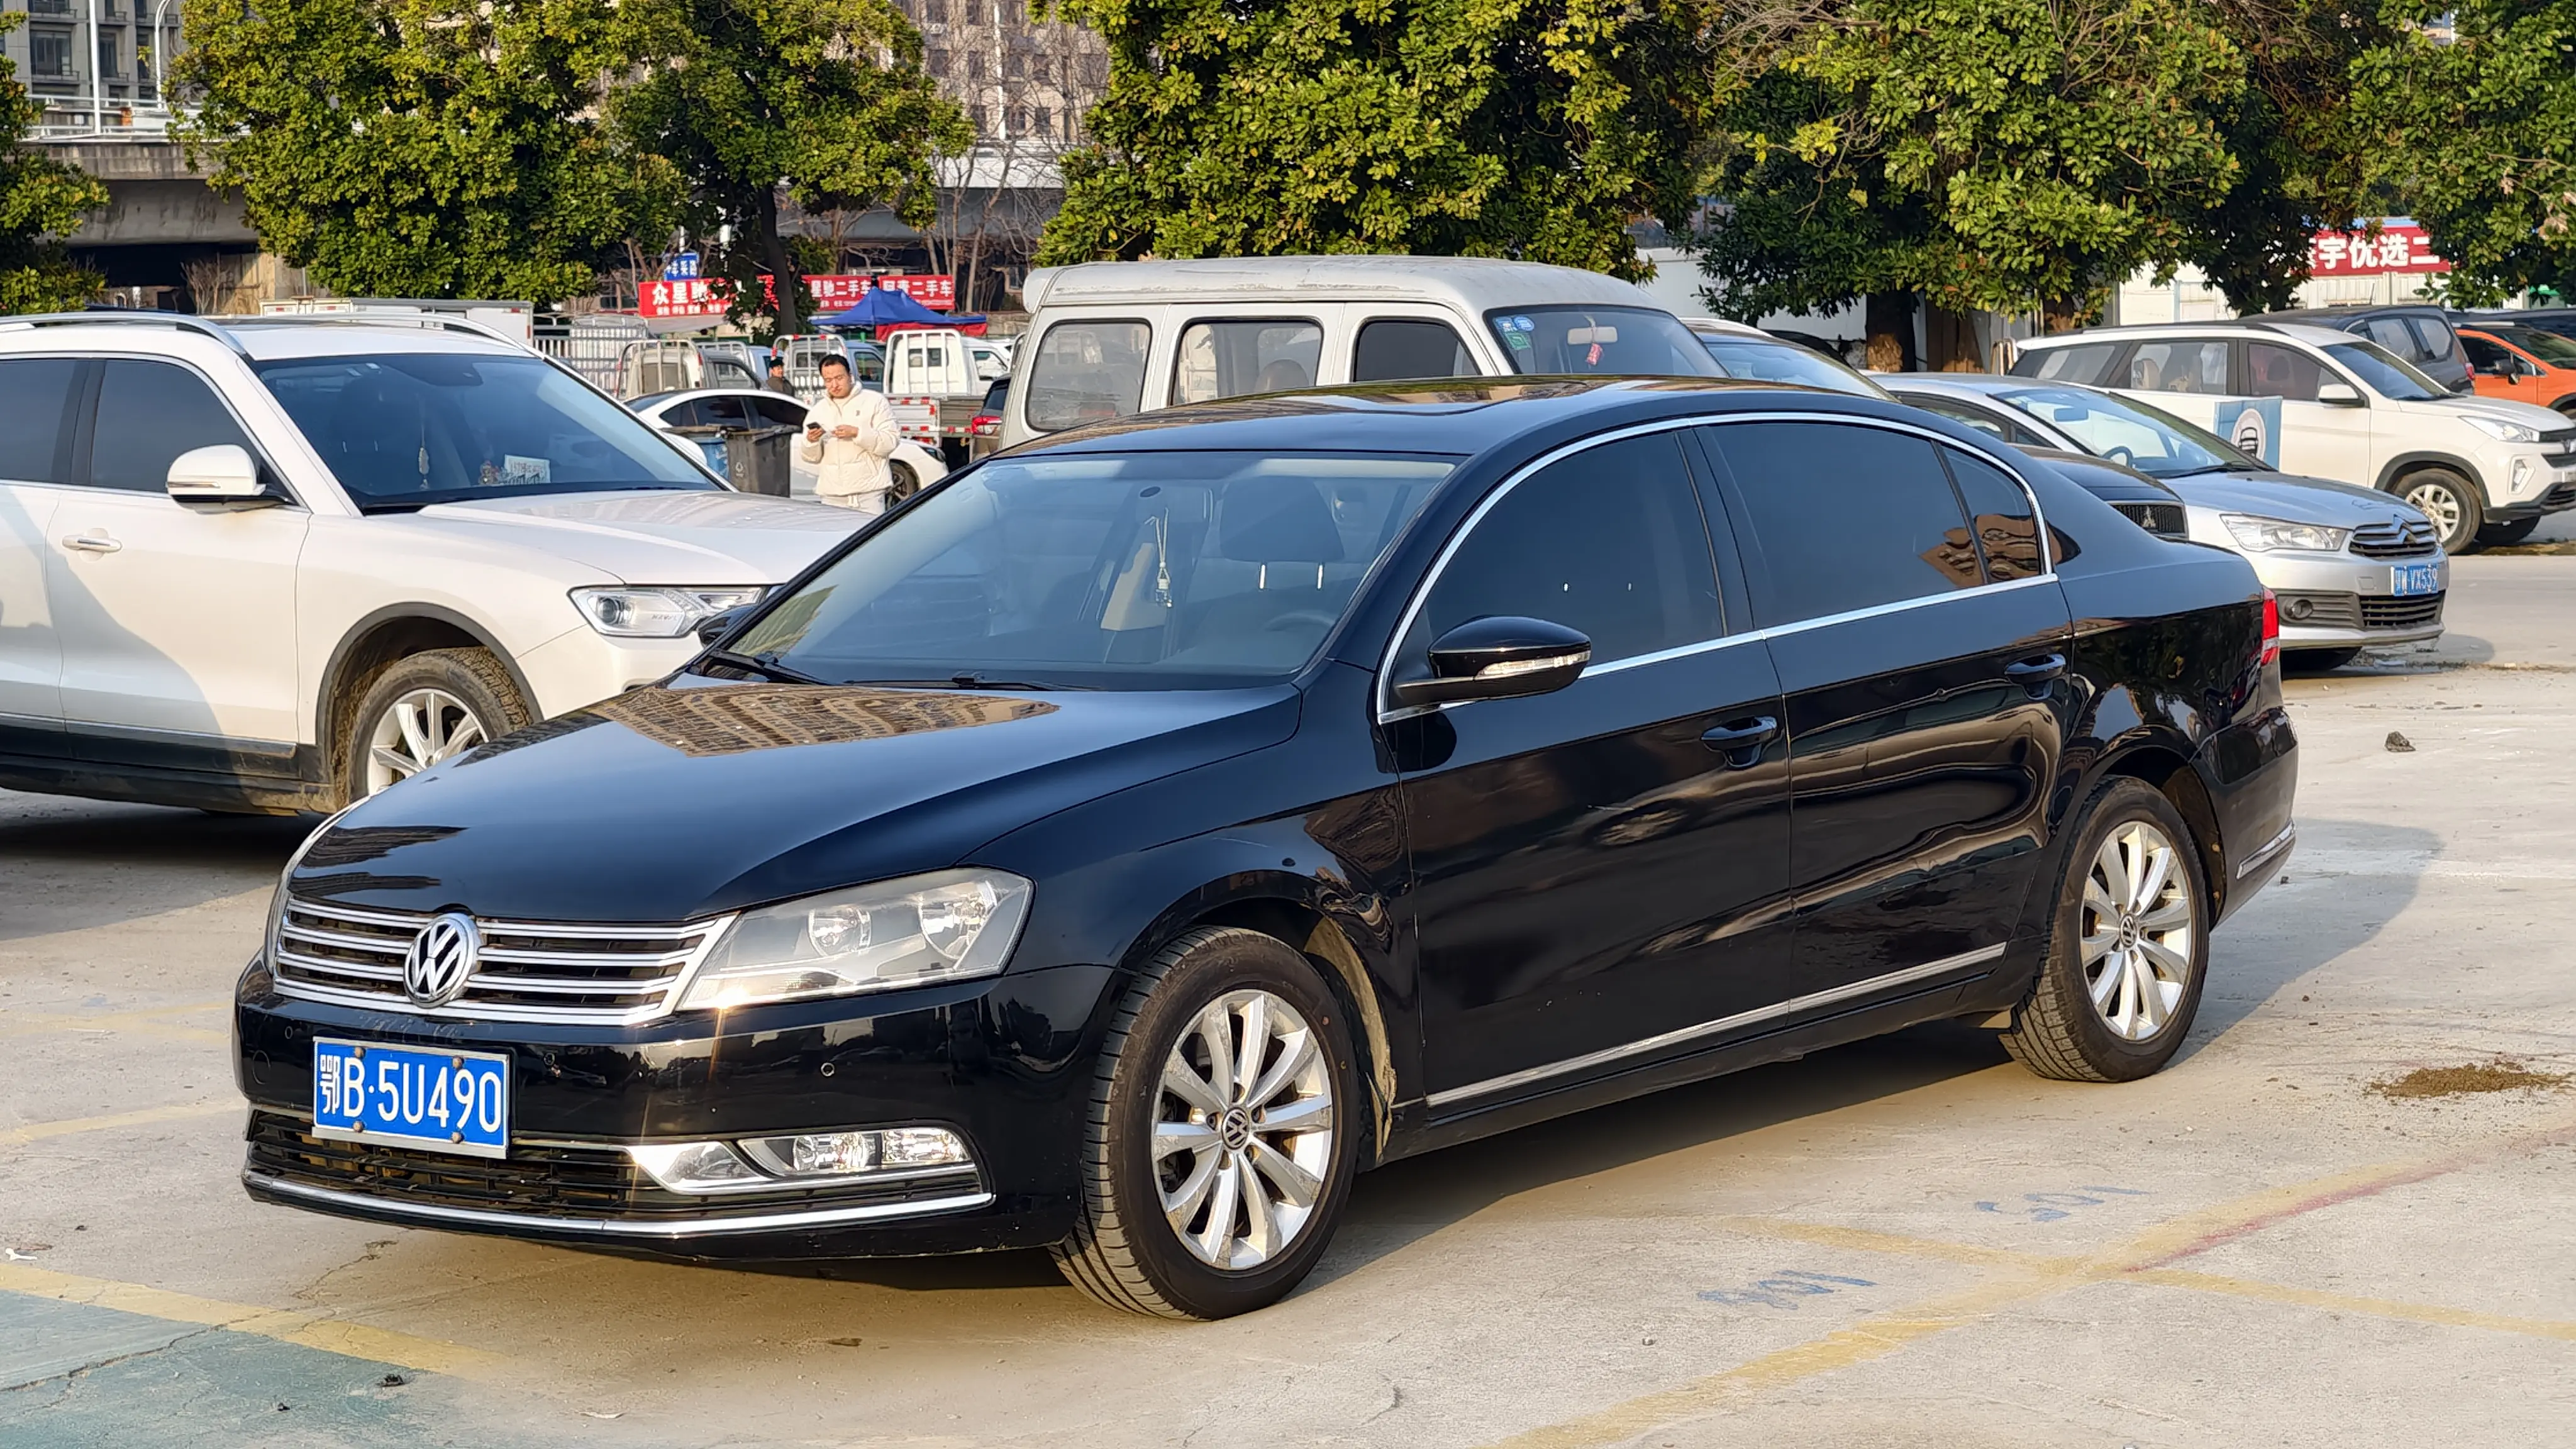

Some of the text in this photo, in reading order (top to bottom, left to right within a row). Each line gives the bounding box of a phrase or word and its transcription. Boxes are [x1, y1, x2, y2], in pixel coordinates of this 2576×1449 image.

[2307, 233, 2440, 270] 宇优选二
[801, 279, 871, 297] 星驰二手车
[319, 1054, 502, 1133] 鄂B·5U490
